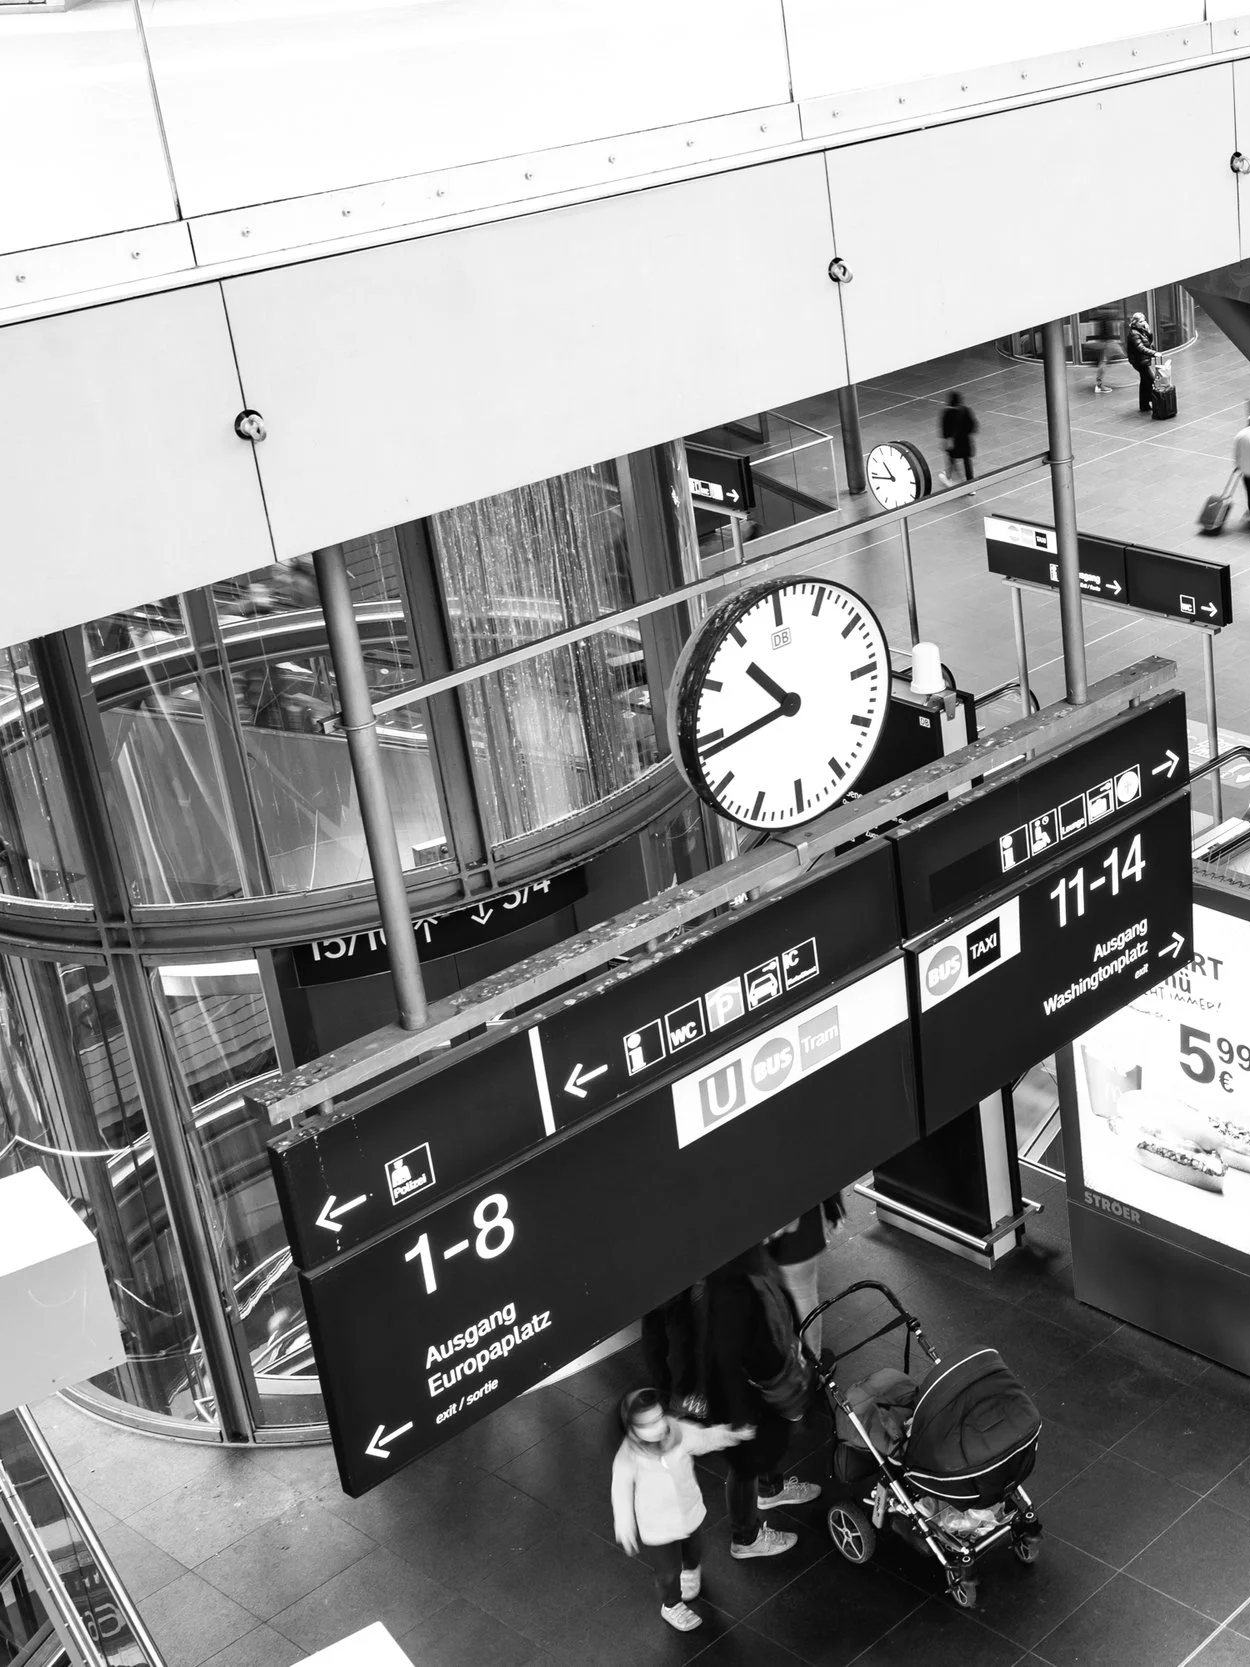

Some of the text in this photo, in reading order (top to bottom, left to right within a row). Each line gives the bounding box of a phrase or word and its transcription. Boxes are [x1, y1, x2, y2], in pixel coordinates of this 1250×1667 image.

[1079, 572, 1100, 584] sgang
[773, 631, 789, 647] DB
[1062, 817, 1085, 833] Lounge
[1050, 834, 1146, 928] 11-14
[970, 933, 997, 960] TAXI
[1093, 918, 1148, 962] Ausgang
[928, 954, 961, 988] BUS
[1043, 941, 1149, 1016] Washingtonplatz
[1134, 963, 1149, 979] exit
[1165, 971, 1191, 993] nü
[1185, 952, 1223, 981] RT
[715, 994, 734, 1026] P
[670, 1021, 697, 1046] WC
[801, 1025, 838, 1054] Tram
[754, 1047, 792, 1084] BUS
[707, 1066, 737, 1116] U
[1218, 1070, 1235, 1094] €
[393, 1173, 427, 1199] Polizei
[1084, 1191, 1141, 1224] STRÖER
[404, 1193, 515, 1295] 1-8
[424, 1303, 517, 1368] Ausgang
[428, 1311, 552, 1398] Europaplatz
[435, 1403, 459, 1426] exit
[466, 1376, 499, 1407] sortie
